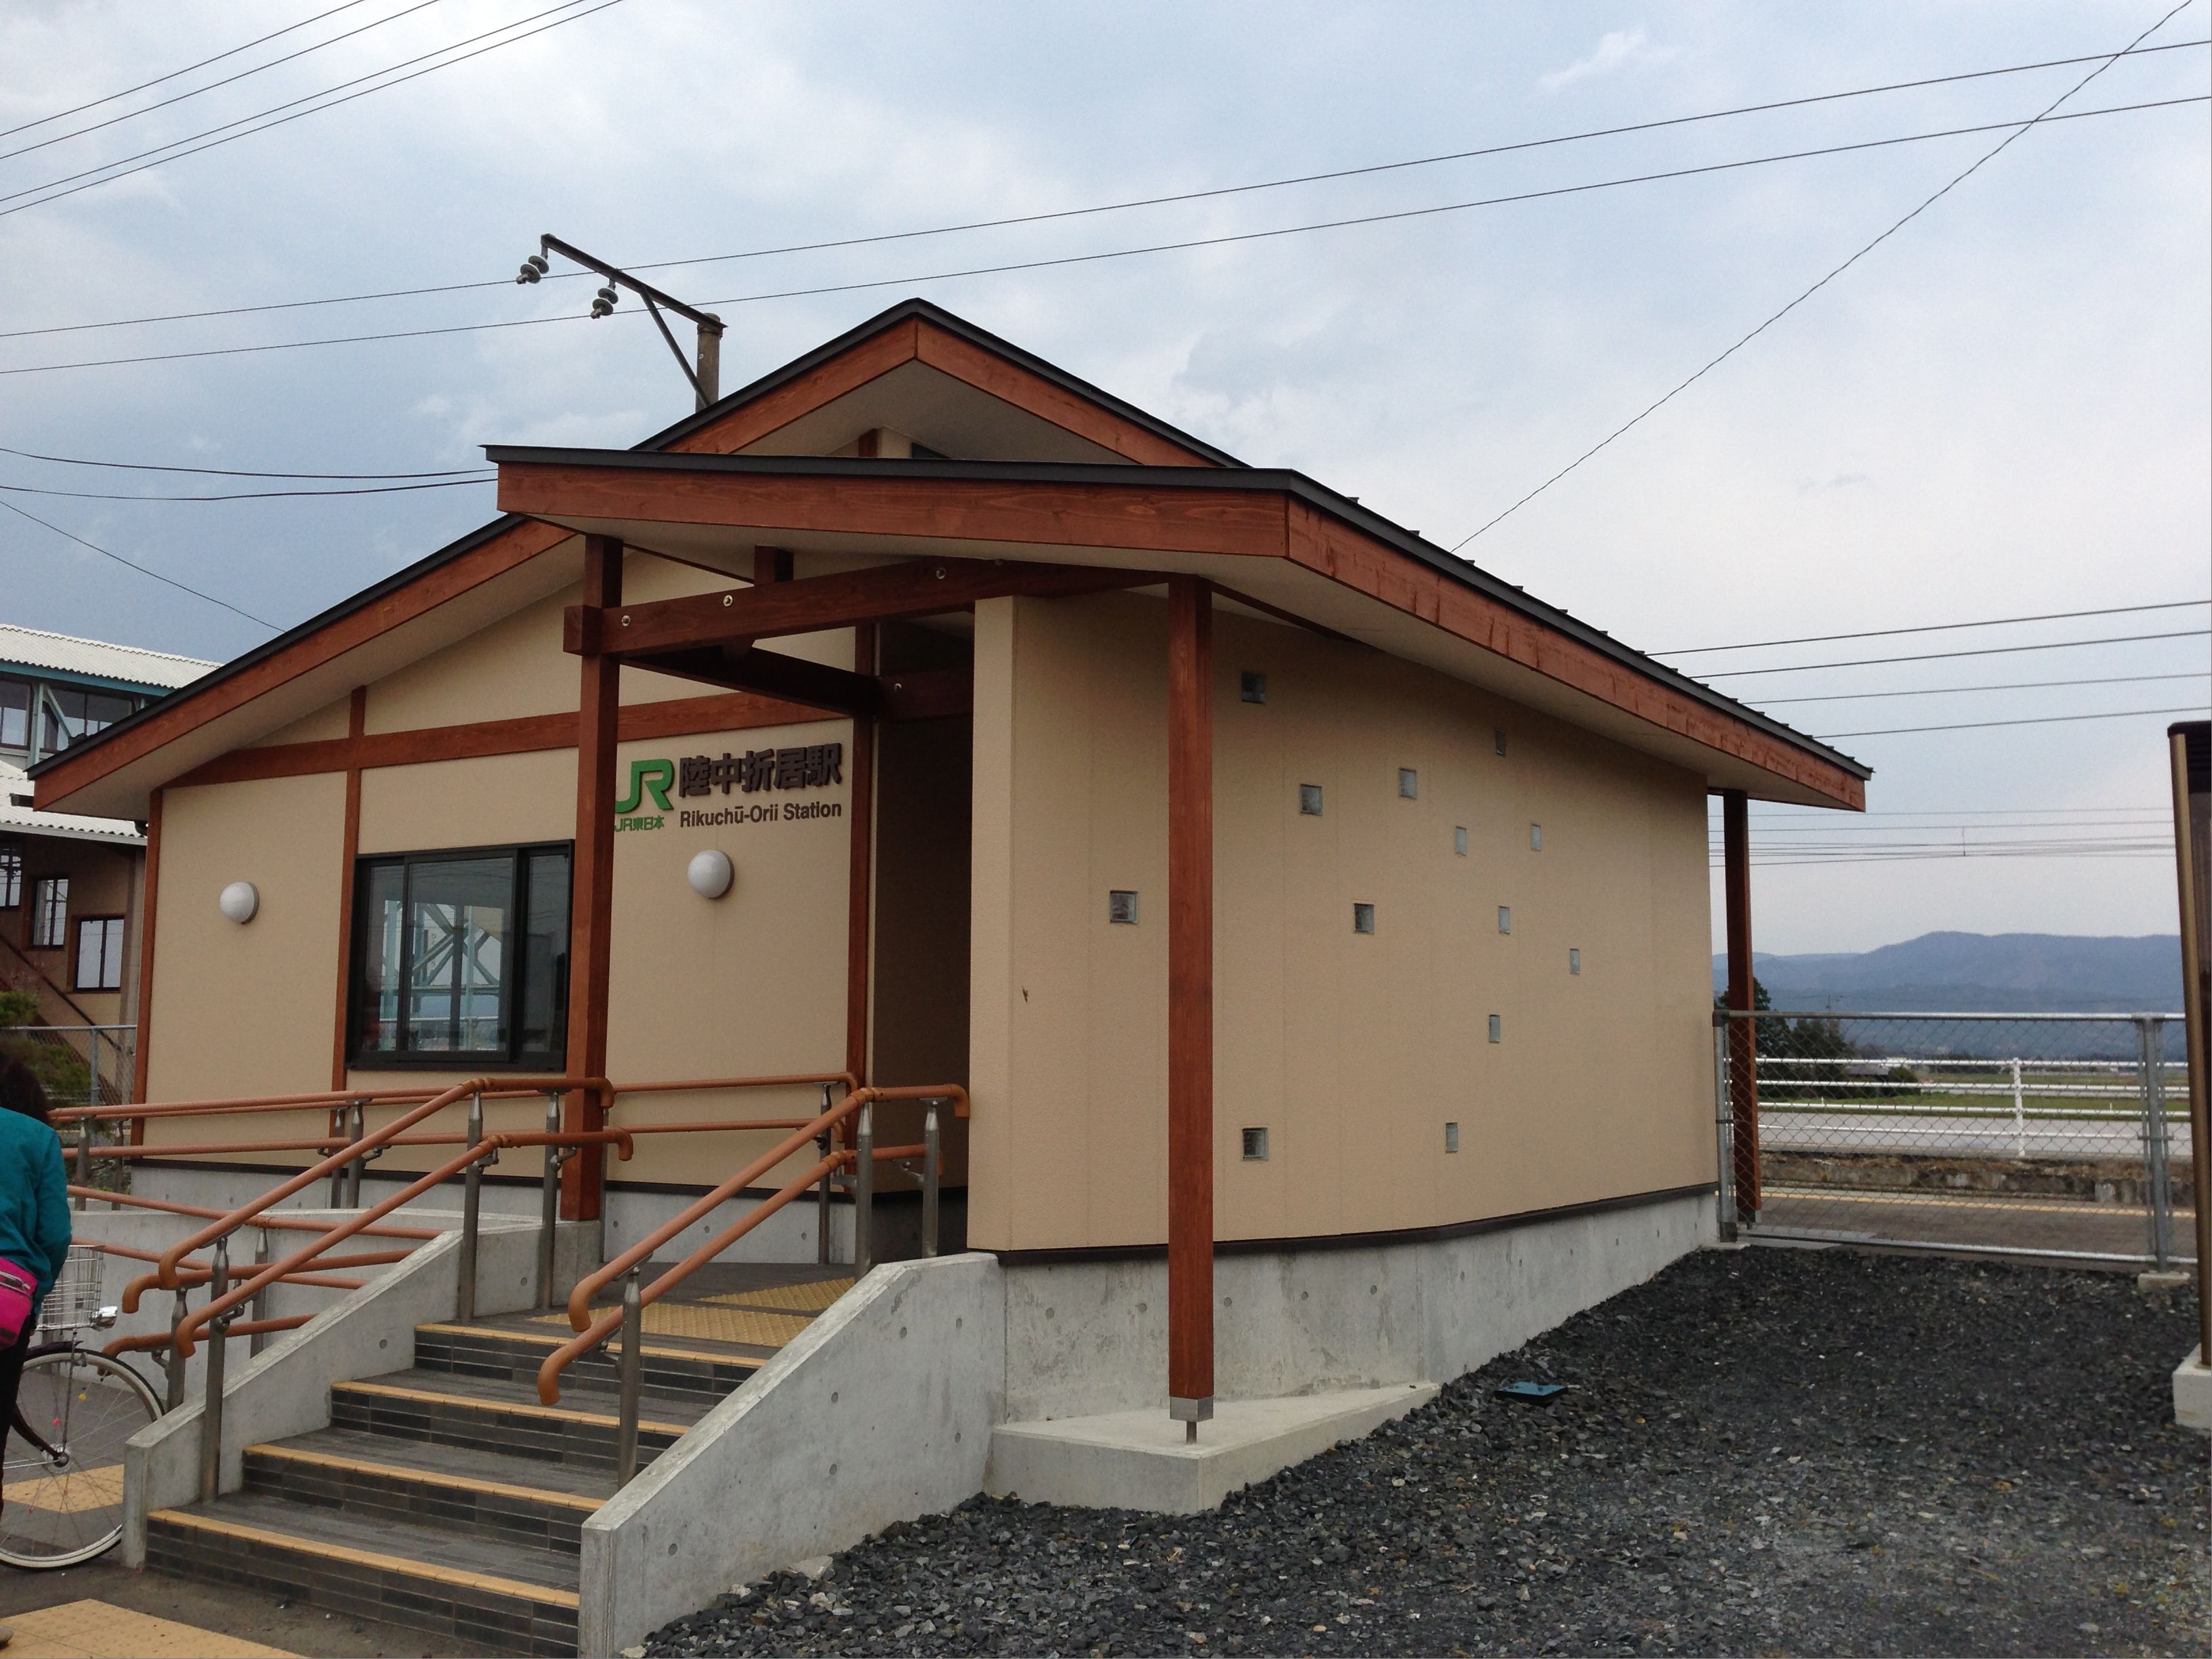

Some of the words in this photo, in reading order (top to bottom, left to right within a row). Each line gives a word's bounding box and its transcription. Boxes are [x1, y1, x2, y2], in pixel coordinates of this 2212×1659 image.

[614, 759, 675, 814] JR
[679, 742, 842, 798] 陸中折居駅
[614, 815, 665, 832] JR東日本
[680, 804, 778, 828] Rikuchū-Orii
[783, 801, 841, 820] Station
